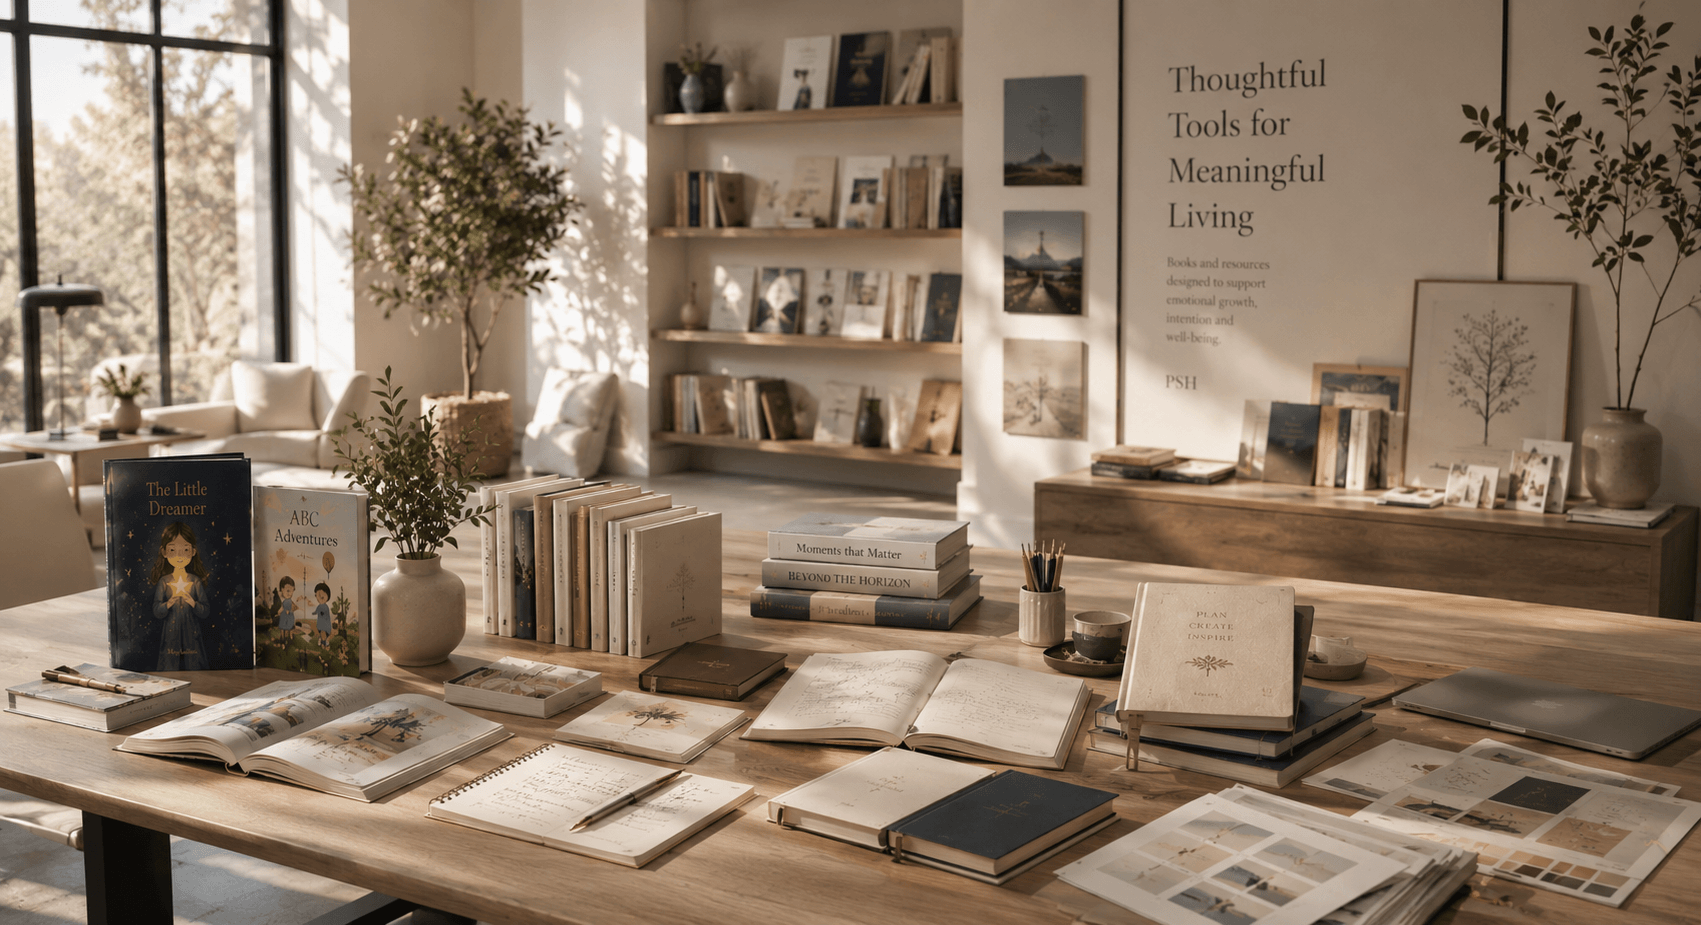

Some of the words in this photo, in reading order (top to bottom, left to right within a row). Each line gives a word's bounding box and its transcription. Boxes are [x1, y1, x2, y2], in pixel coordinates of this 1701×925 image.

[1168, 58, 1327, 99] Thoughtful
[1168, 109, 1241, 138] Tools
[1251, 108, 1290, 136] for
[1168, 154, 1326, 191] Meaningful
[1168, 202, 1254, 237] Living
[1167, 256, 1197, 268] Books
[1200, 257, 1219, 268] and
[1221, 260, 1270, 270] resources
[1166, 274, 1211, 289] designed
[1213, 278, 1224, 287] to
[1226, 279, 1266, 291] support
[1166, 294, 1216, 306] emotional
[1218, 296, 1258, 310] growth,
[1166, 312, 1212, 325] intention
[1214, 314, 1234, 326] and
[1166, 331, 1221, 347] well-being.
[1165, 374, 1197, 390] PSH
[146, 482, 171, 497] The
[174, 480, 207, 497] Little
[149, 501, 207, 516] Dreamer
[289, 509, 320, 528] ABC
[274, 528, 338, 547] Adventures
[796, 543, 842, 556] Moments
[844, 545, 864, 557] that
[867, 547, 902, 560] Matter
[788, 571, 831, 583] BEYOND
[834, 573, 856, 585] THE
[859, 576, 911, 589] HORIZON
[1196, 611, 1227, 619] PLAN
[1188, 622, 1234, 630] CREATE
[1187, 633, 1234, 642] INSPIRE
